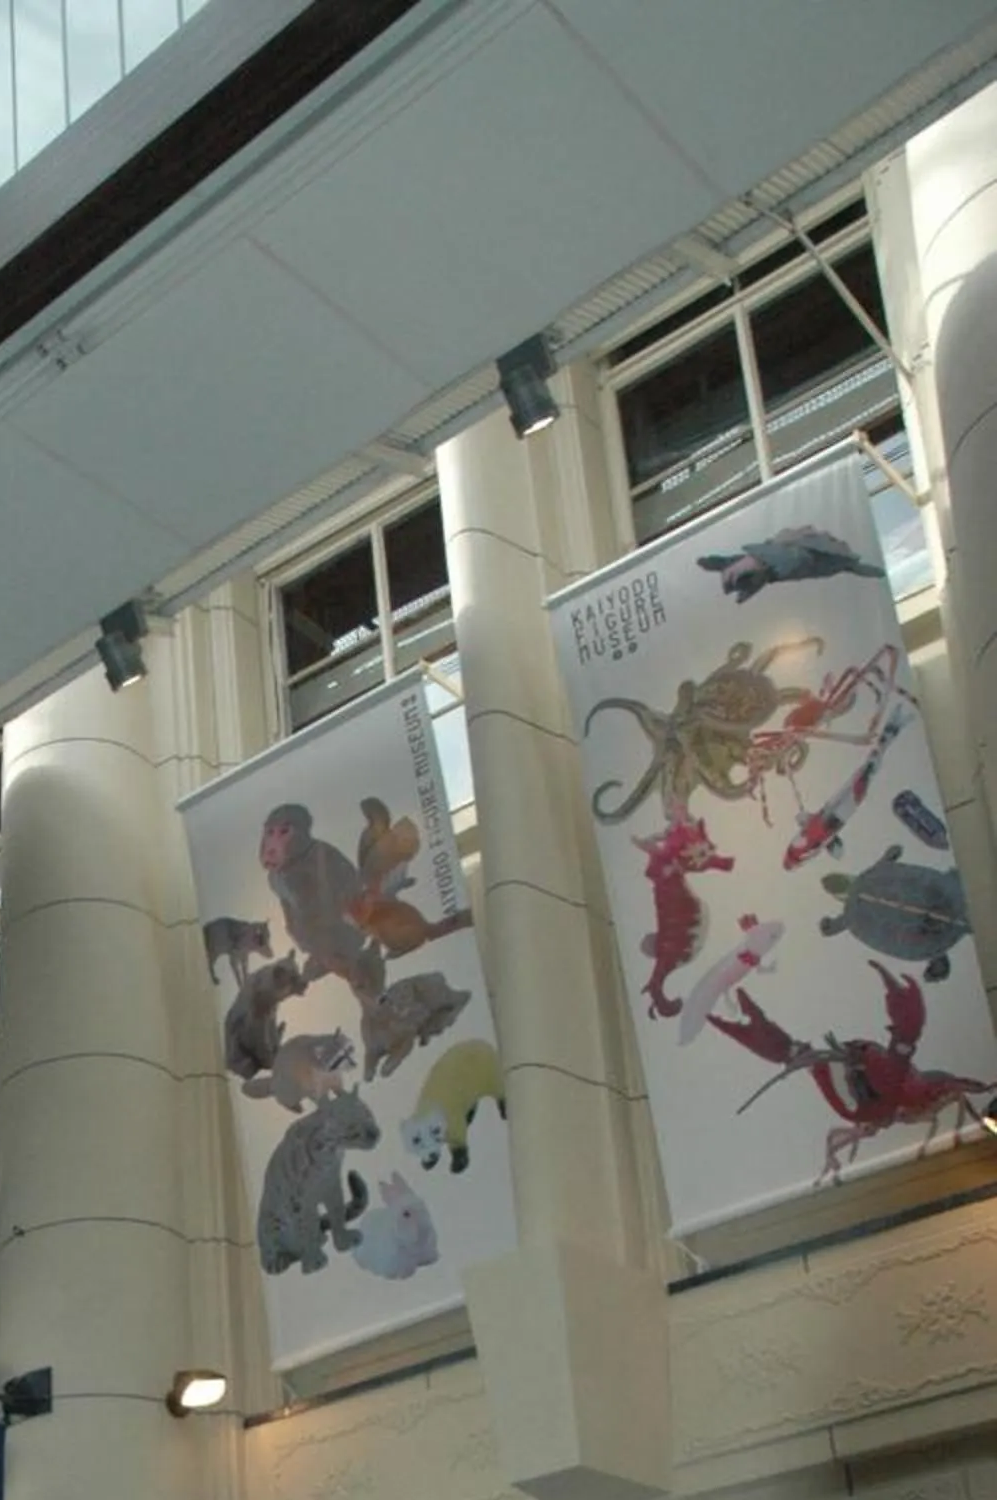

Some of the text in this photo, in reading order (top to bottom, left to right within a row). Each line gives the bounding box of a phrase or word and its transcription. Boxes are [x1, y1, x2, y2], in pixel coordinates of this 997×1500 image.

[570, 571, 658, 629] KAIYODO
[574, 591, 662, 645] FIGURE
[579, 608, 666, 665] MUSEUM
[403, 709, 458, 917] AIYODO FIGURE MUSEUM
